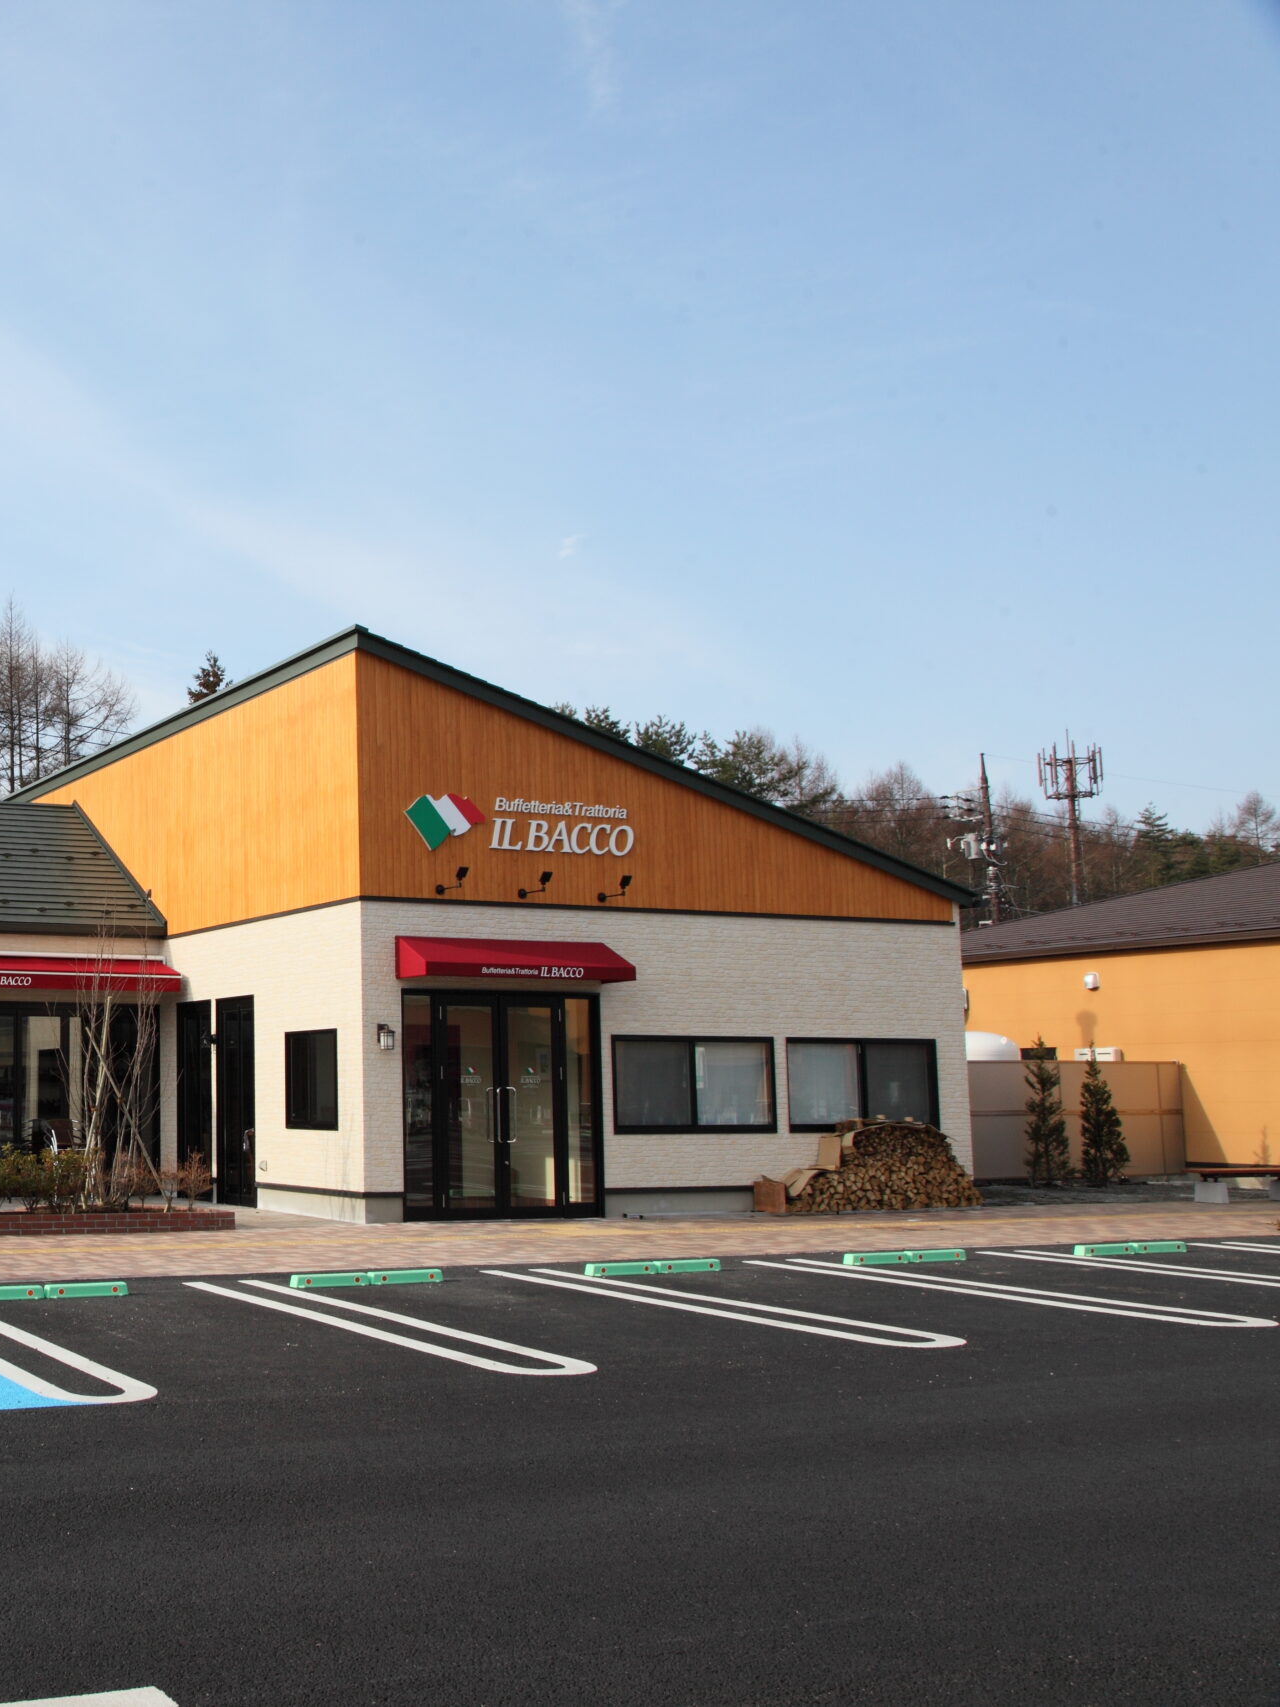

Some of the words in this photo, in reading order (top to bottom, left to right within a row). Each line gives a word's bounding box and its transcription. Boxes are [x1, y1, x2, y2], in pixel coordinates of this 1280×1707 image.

[495, 797, 627, 819] Buffetteria&Trattoria
[489, 817, 522, 851] IL
[524, 818, 634, 857] BACCO
[540, 966, 550, 977] IL
[551, 967, 584, 978] BACCO
[0, 976, 32, 986] BACCO
